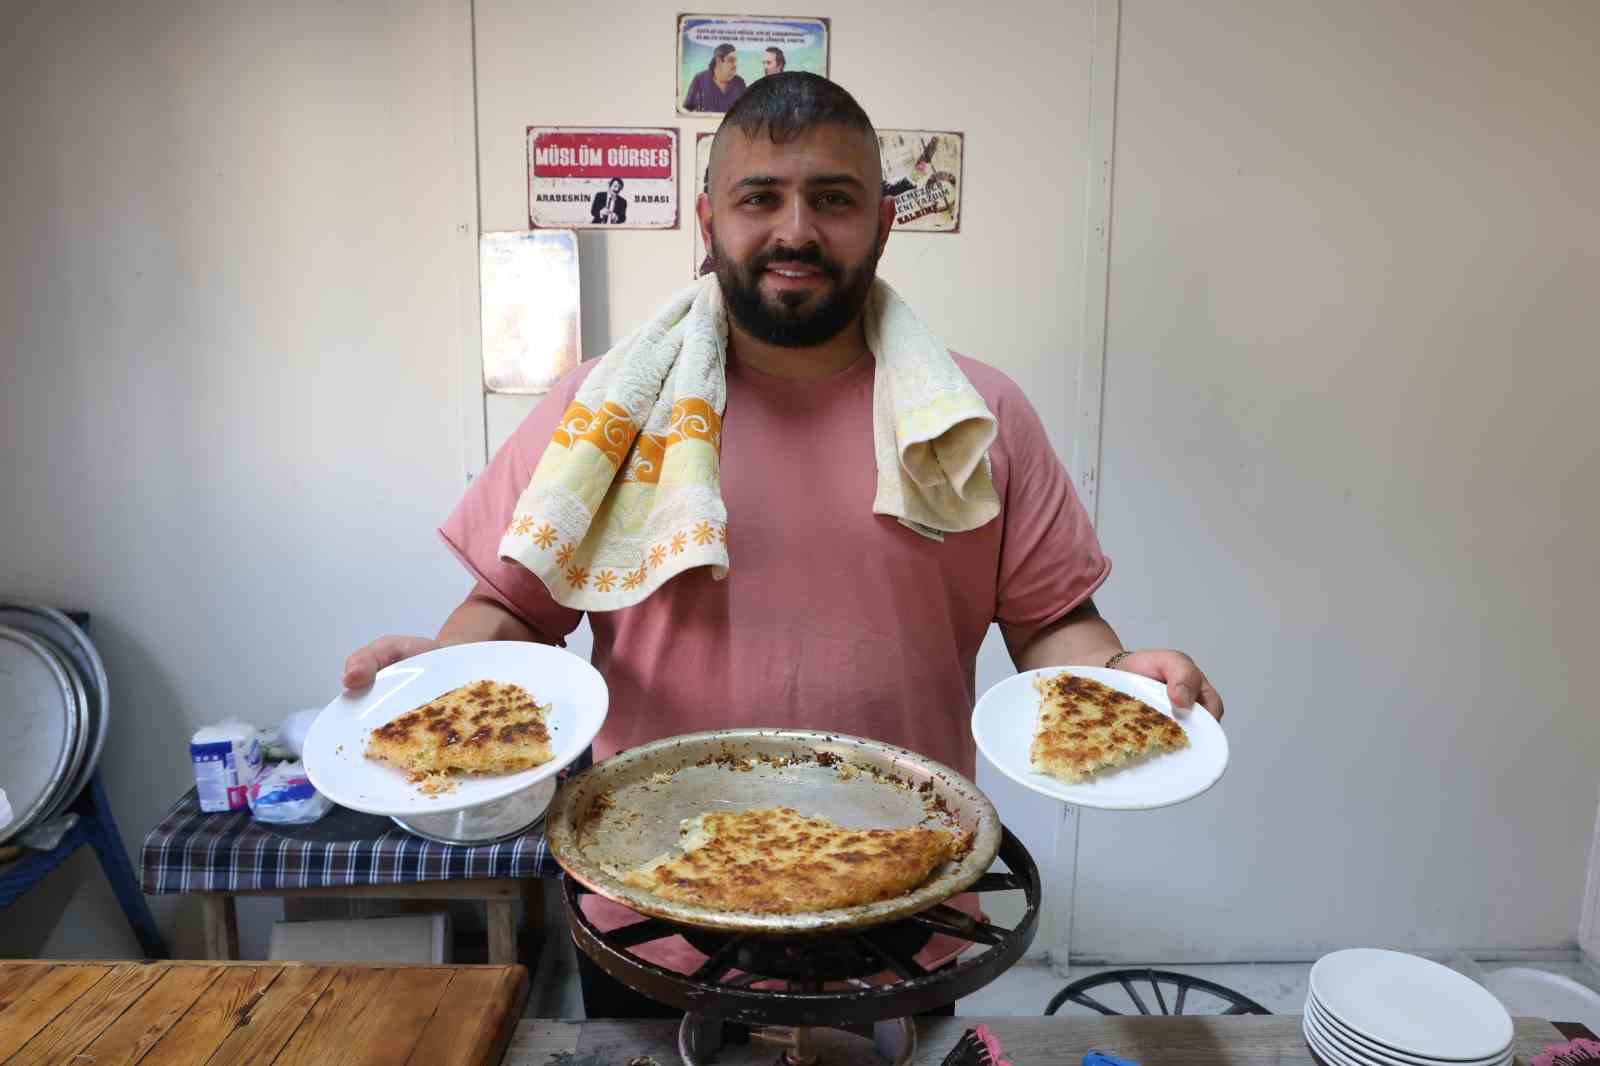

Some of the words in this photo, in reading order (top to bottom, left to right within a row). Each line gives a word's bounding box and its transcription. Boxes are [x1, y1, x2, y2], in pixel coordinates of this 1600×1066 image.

[535, 144, 602, 167] MÜSLÜM
[608, 145, 670, 168] GÜRSES
[536, 194, 591, 203] ARABESKİN
[635, 195, 669, 203] BABASI
